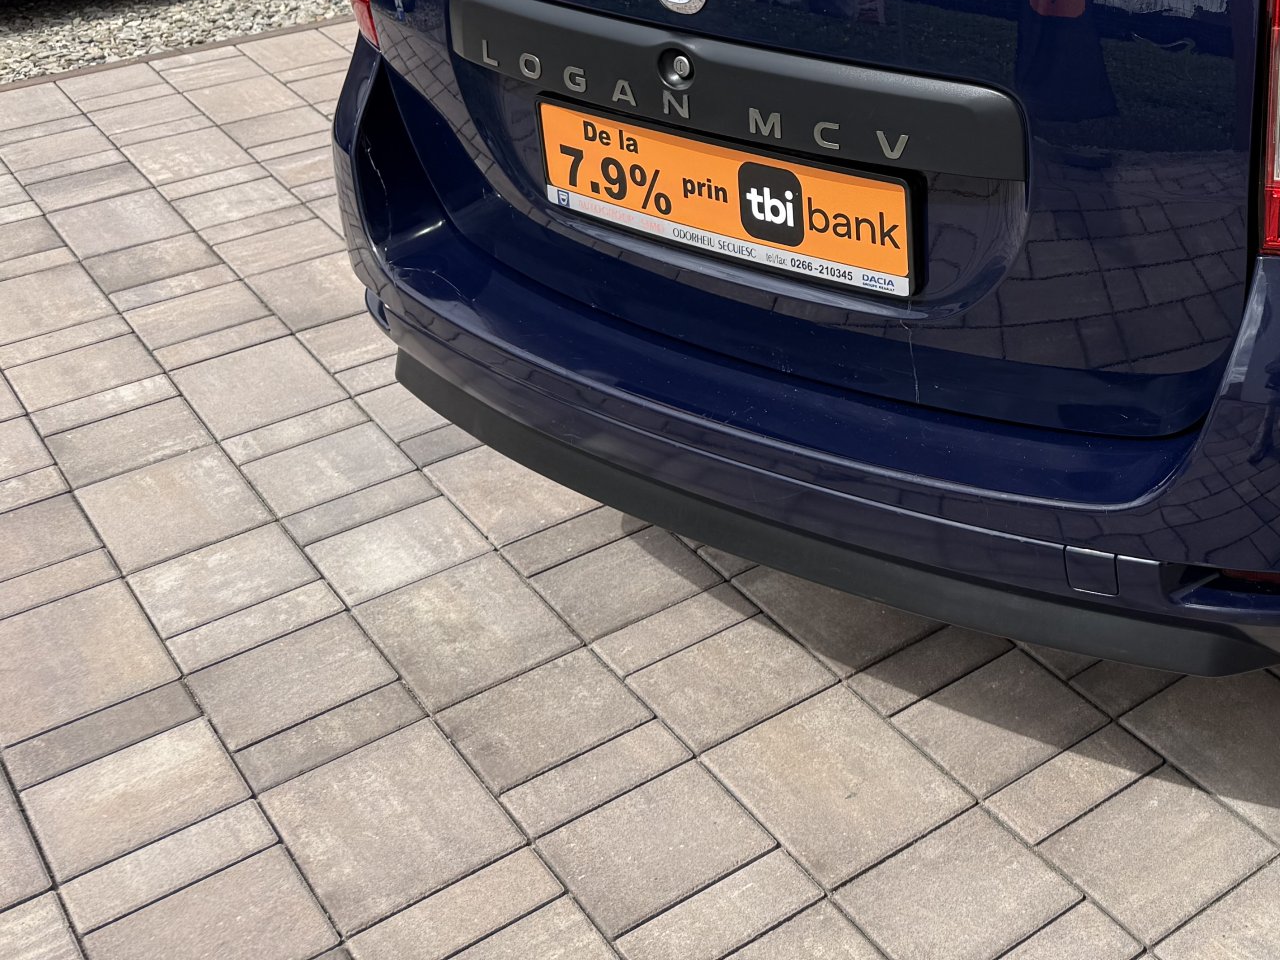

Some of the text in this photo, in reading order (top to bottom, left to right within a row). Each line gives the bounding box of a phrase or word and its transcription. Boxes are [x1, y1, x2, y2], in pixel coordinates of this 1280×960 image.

[481, 39, 690, 119] LOGAN
[582, 120, 639, 154] De la
[559, 143, 901, 250] 7.9% prin tbi bank
[672, 227, 716, 248] ODORHEIU
[717, 239, 757, 259] SECUIESC
[790, 257, 854, 281] 0266-210345
[861, 273, 895, 287] DACIA
